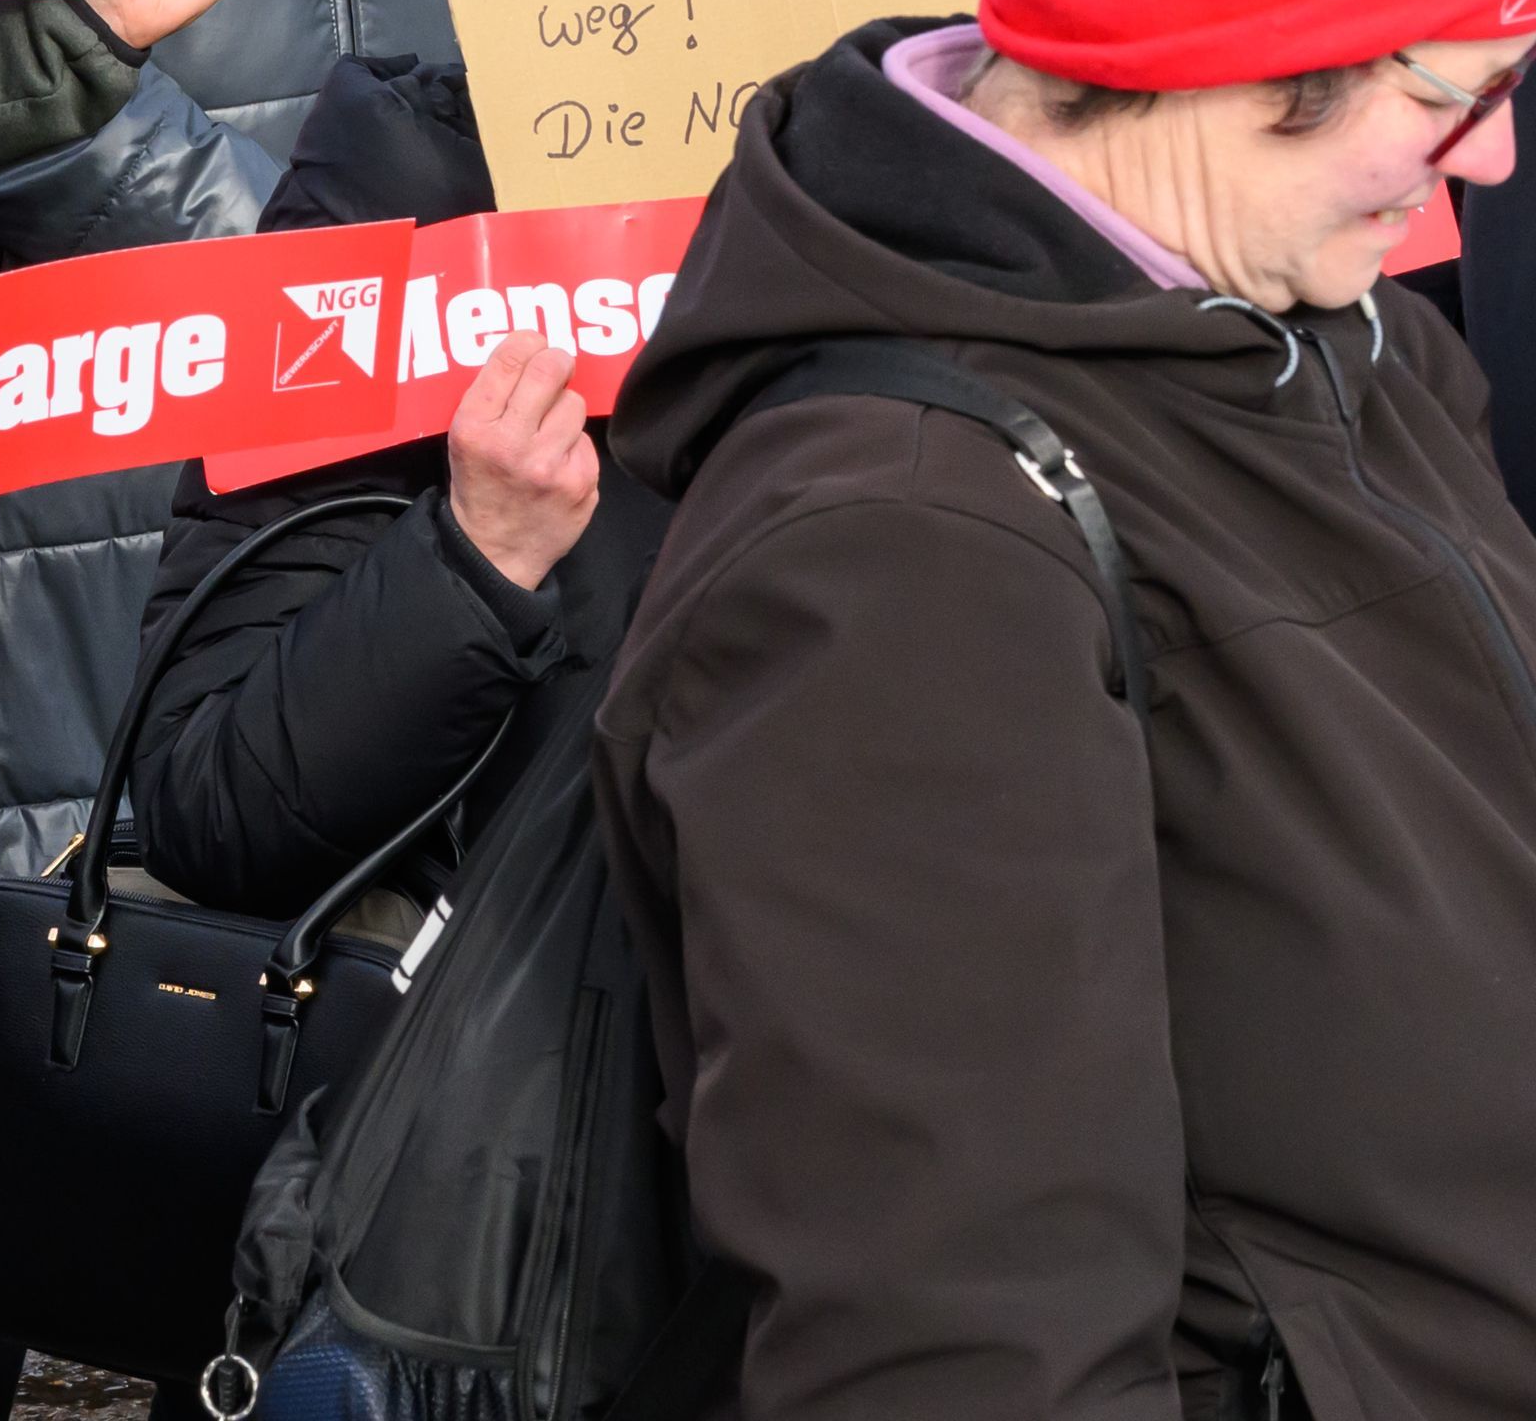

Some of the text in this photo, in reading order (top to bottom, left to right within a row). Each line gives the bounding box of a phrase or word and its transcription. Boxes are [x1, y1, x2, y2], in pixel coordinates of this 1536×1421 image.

[533, 99, 646, 160] Die
[316, 283, 378, 313] NGG
[278, 318, 340, 386] GEWERKSCHAFT
